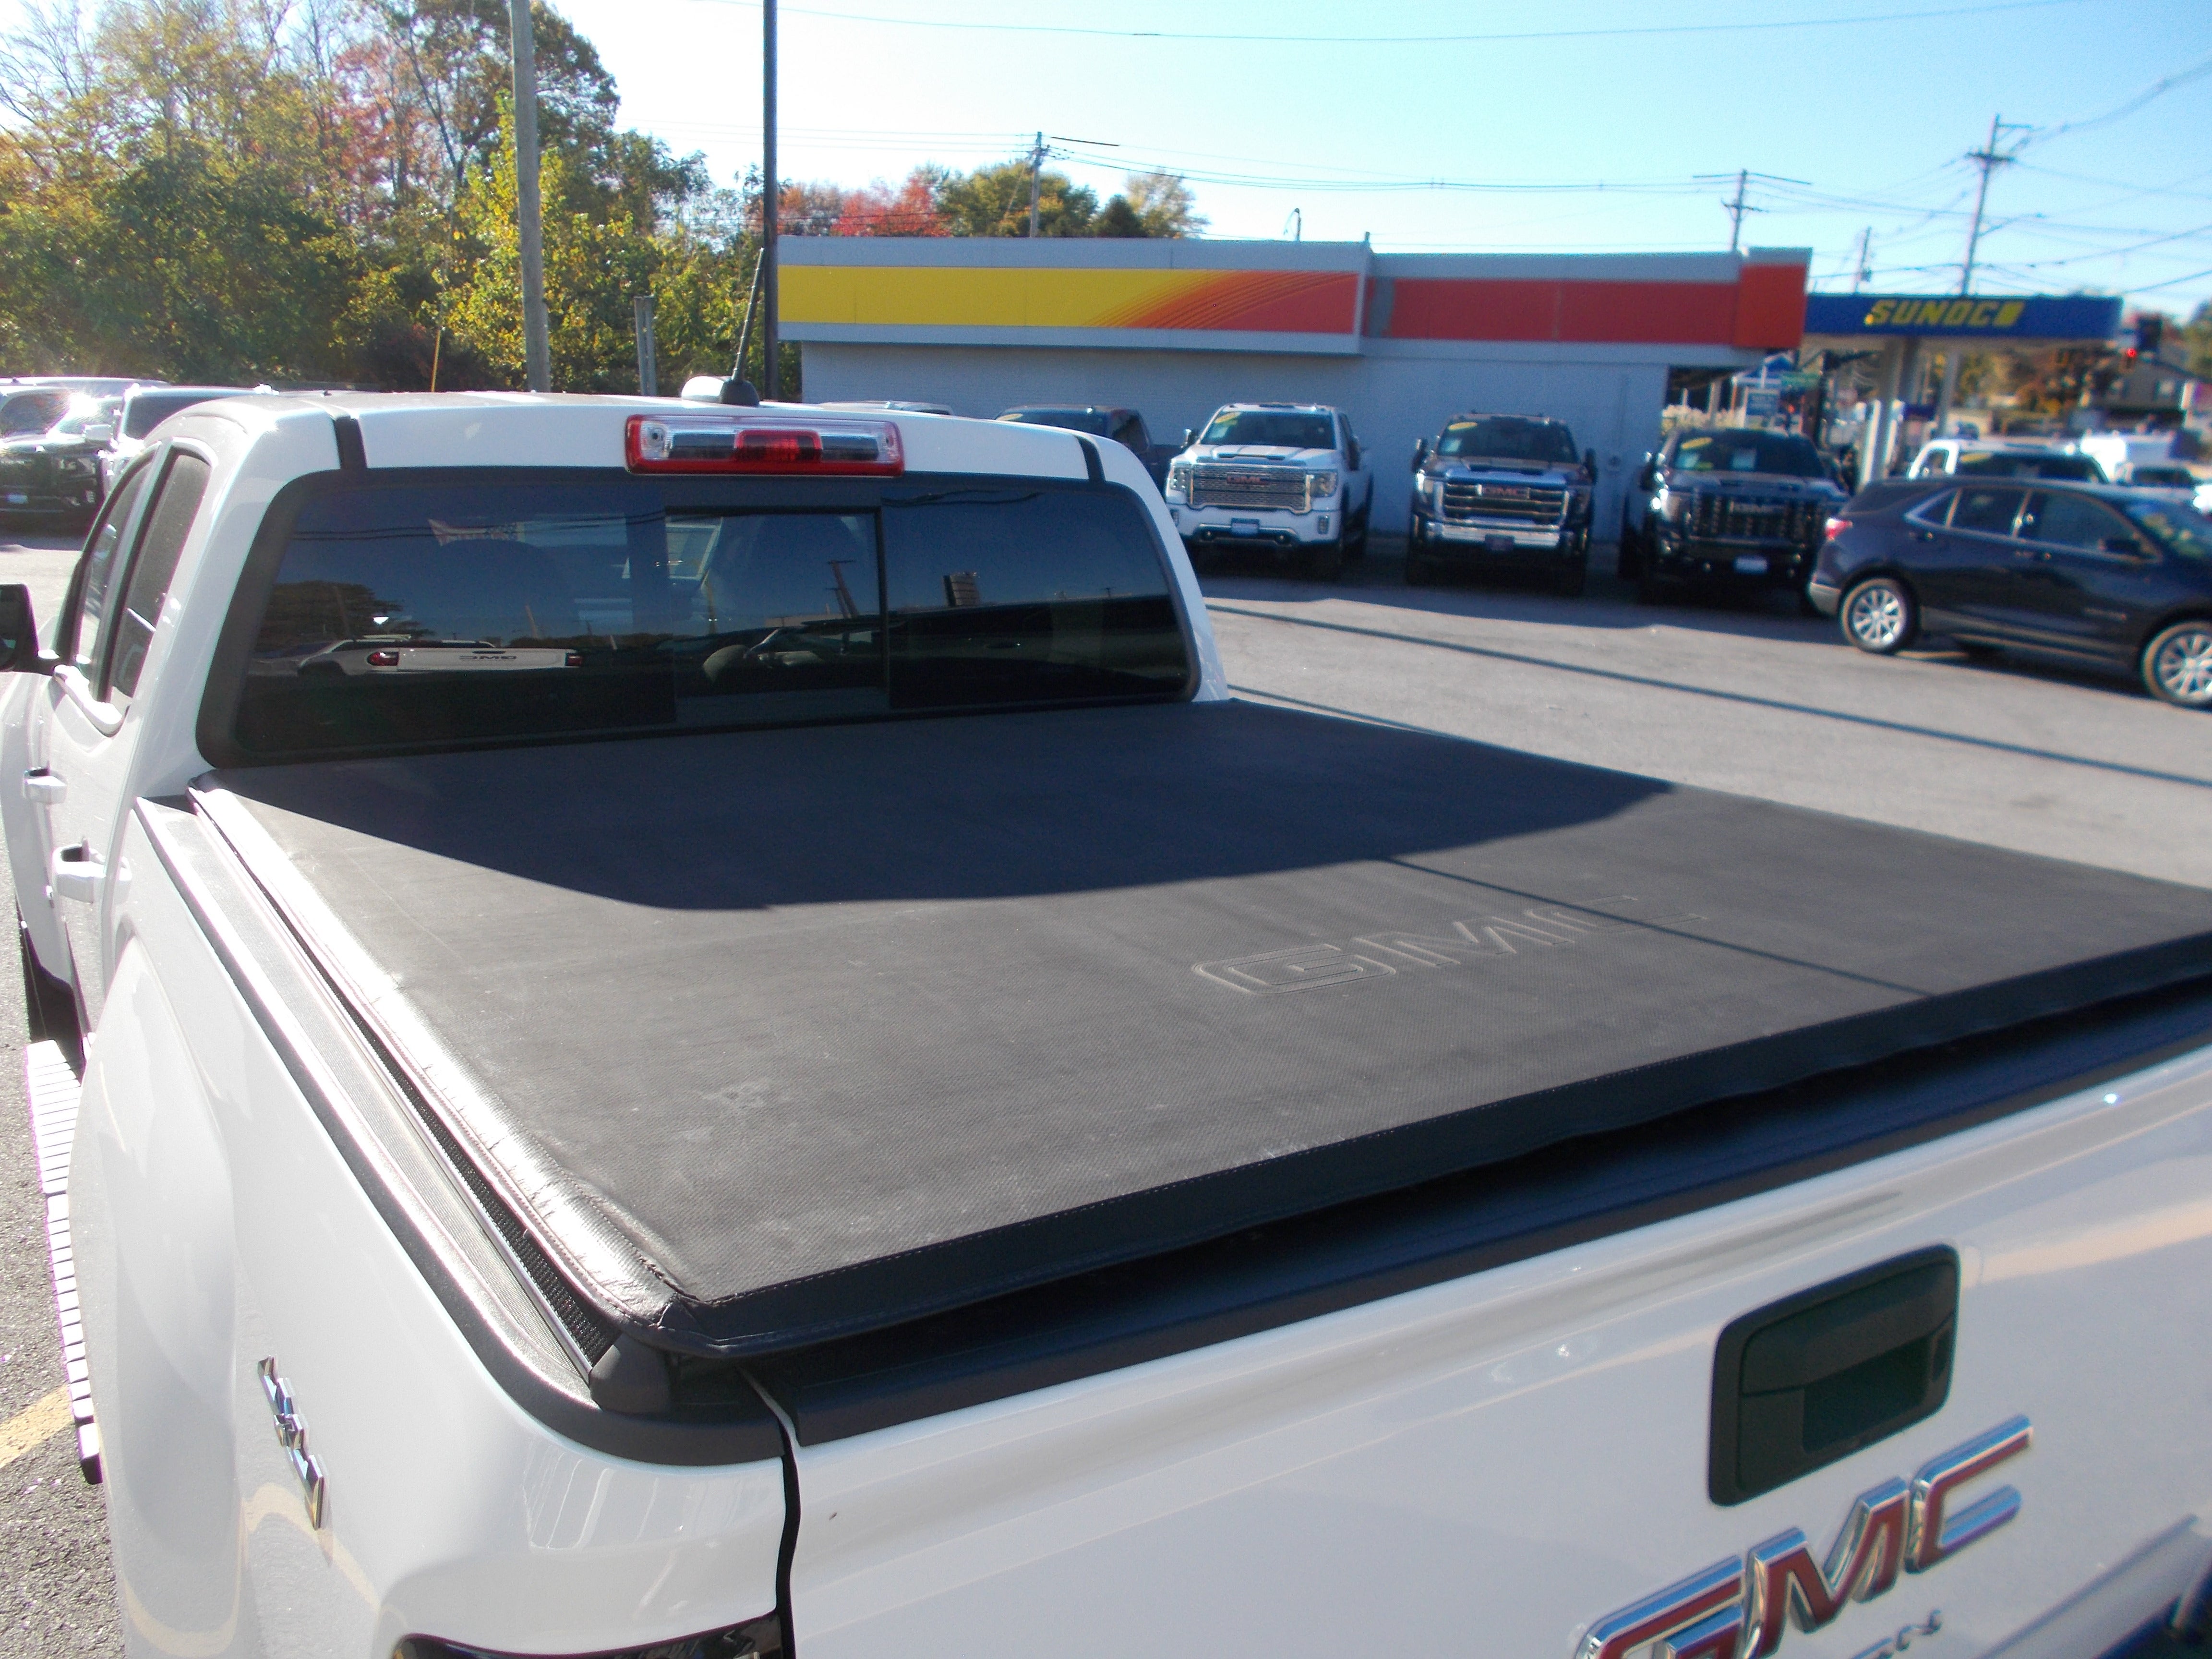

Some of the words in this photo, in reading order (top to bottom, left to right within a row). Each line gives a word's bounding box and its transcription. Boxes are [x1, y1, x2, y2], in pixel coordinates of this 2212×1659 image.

[1865, 300, 2024, 327] SUNOCO
[1192, 895, 1708, 995] GMC
[1573, 1413, 2033, 1659] GMC
